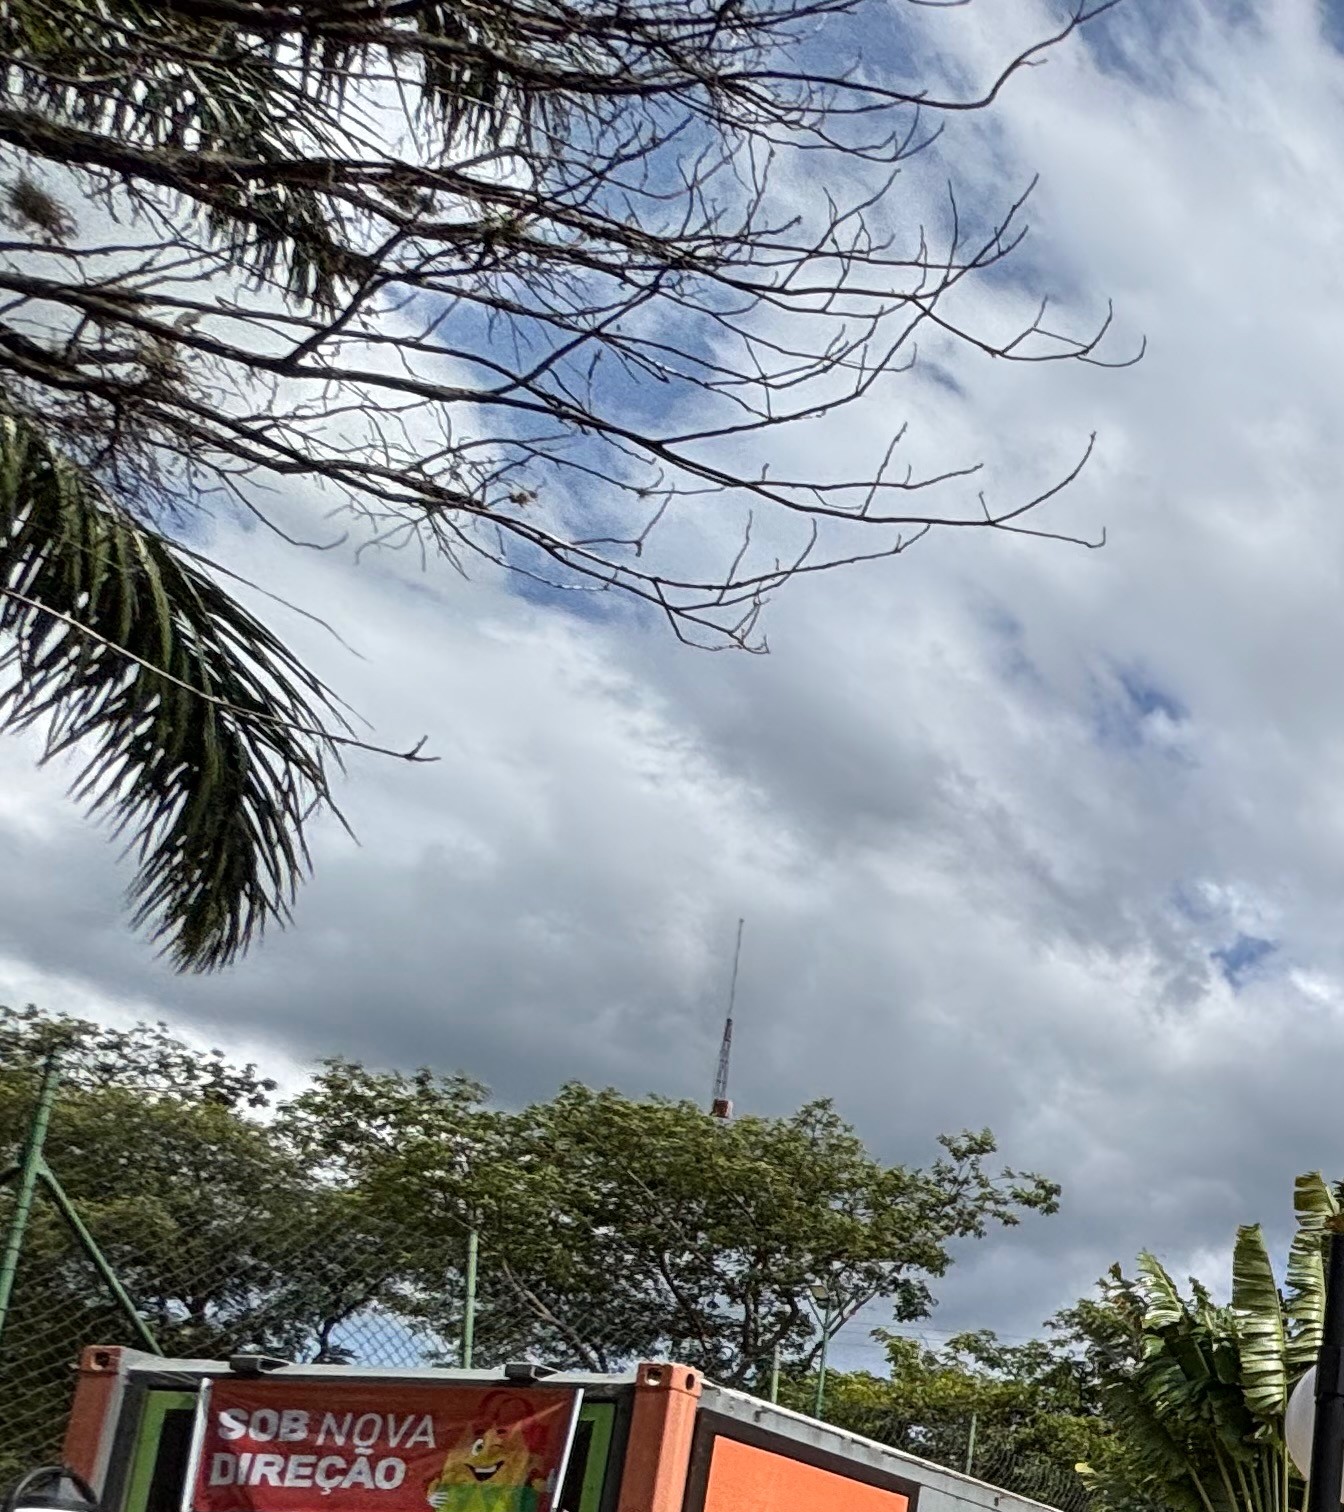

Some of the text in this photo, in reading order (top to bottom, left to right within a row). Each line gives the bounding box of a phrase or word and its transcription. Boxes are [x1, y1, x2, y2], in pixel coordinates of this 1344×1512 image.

[217, 1408, 436, 1449] SOB NOVA
[209, 1446, 407, 1495] DIREÇÃO
